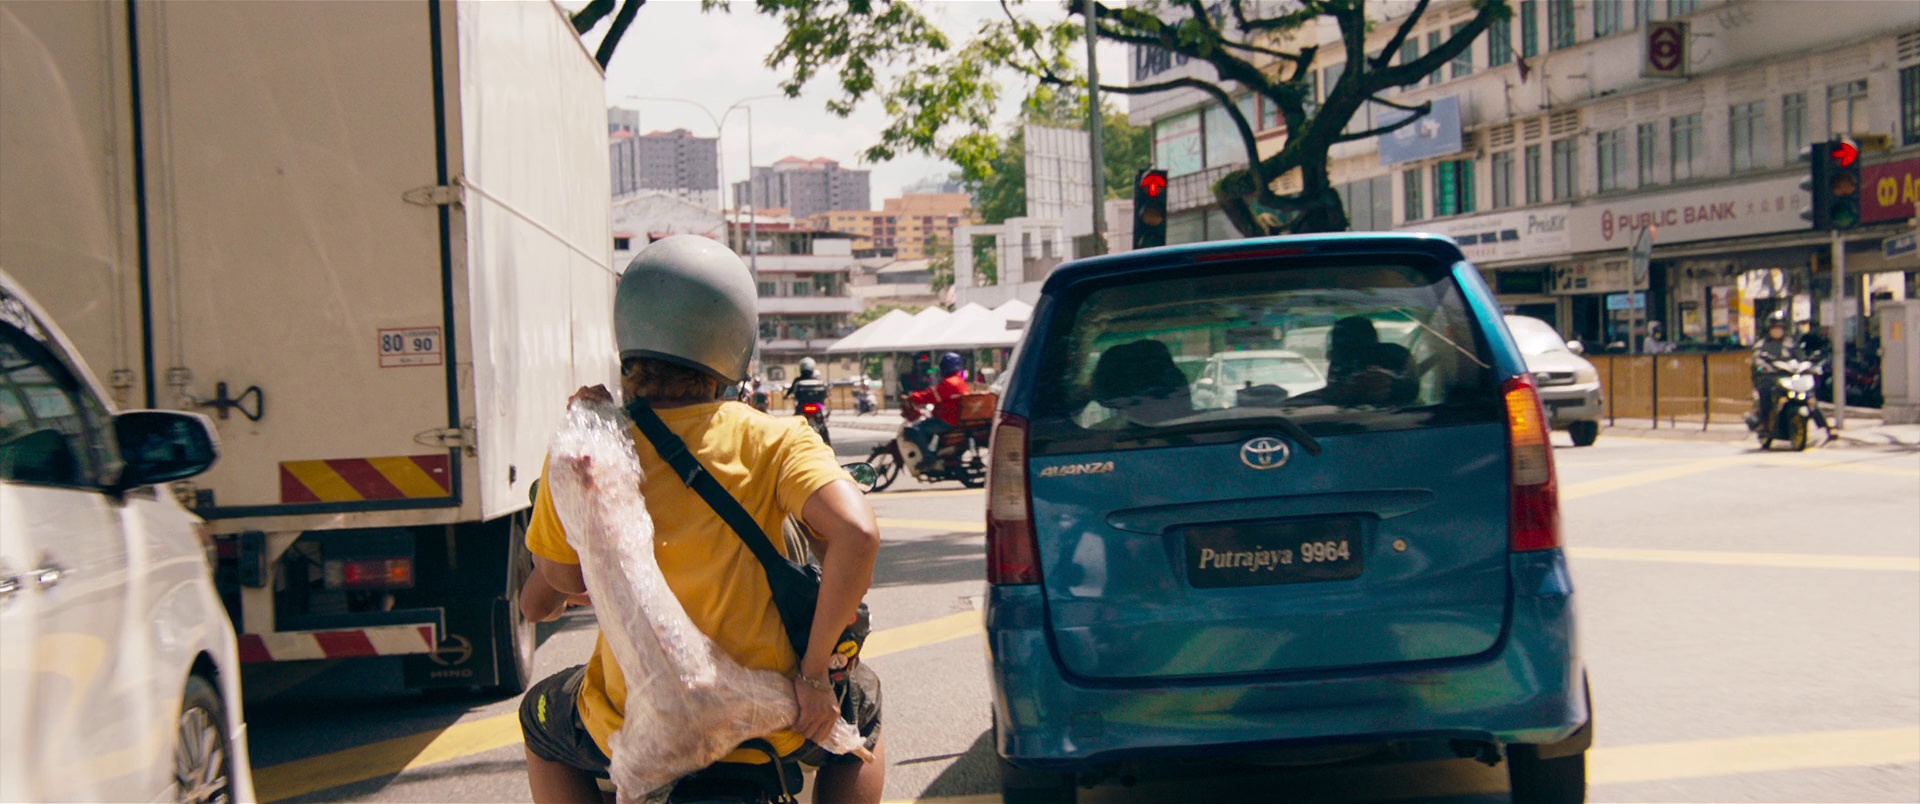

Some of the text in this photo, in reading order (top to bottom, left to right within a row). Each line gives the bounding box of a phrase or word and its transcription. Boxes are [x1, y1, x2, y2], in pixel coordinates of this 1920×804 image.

[1902, 172, 1920, 205] A
[1619, 201, 1736, 232] PUBLIC BANK
[382, 334, 432, 352] 80 90
[1040, 461, 1114, 477] AVANZA
[1199, 540, 1350, 572] Putrajaya 9964
